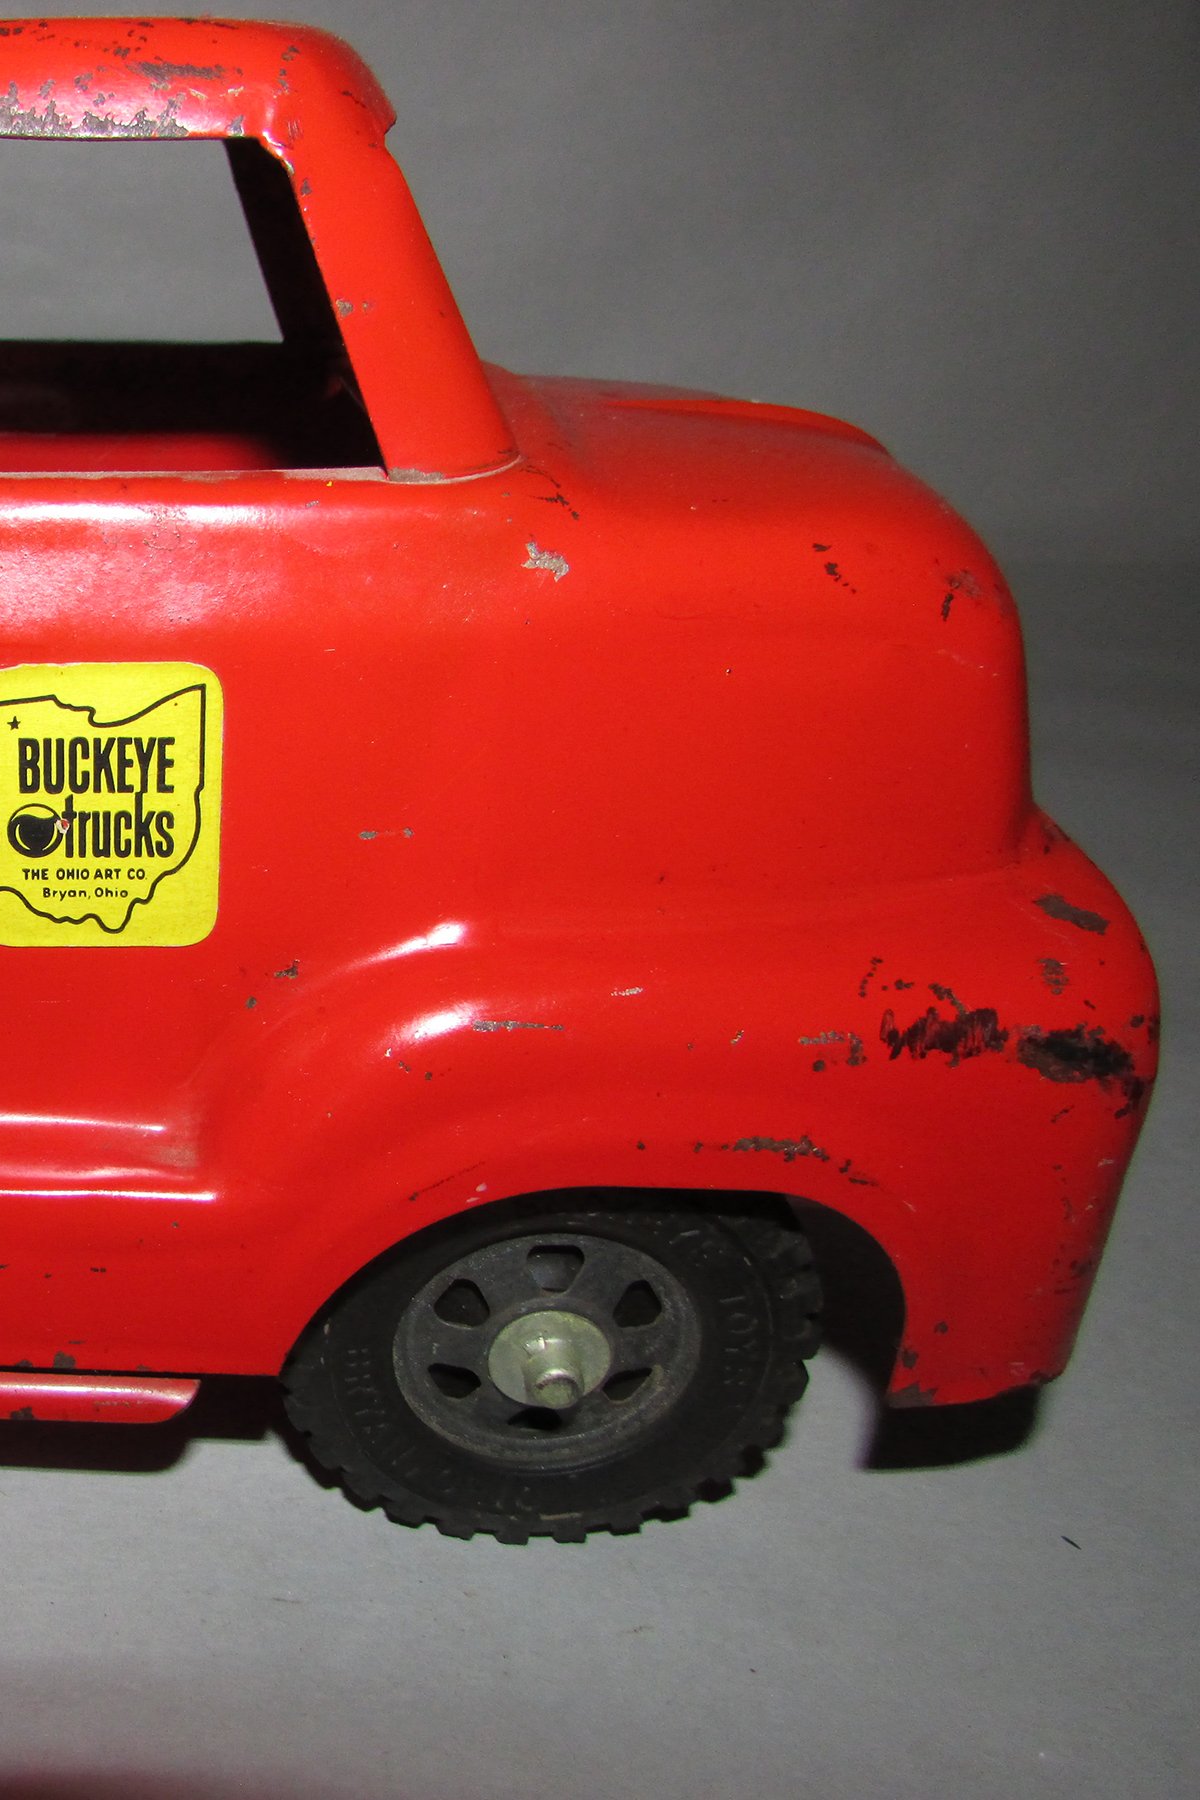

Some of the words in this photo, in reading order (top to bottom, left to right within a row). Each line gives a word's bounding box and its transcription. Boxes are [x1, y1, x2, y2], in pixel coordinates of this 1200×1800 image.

[18, 737, 175, 794] BUCKEYE
[62, 792, 174, 858] trucks
[22, 868, 49, 881] THE
[56, 868, 90, 881] OHIO
[93, 868, 121, 881] ART
[42, 887, 91, 901] Bryan,
[95, 887, 129, 898] Ohio
